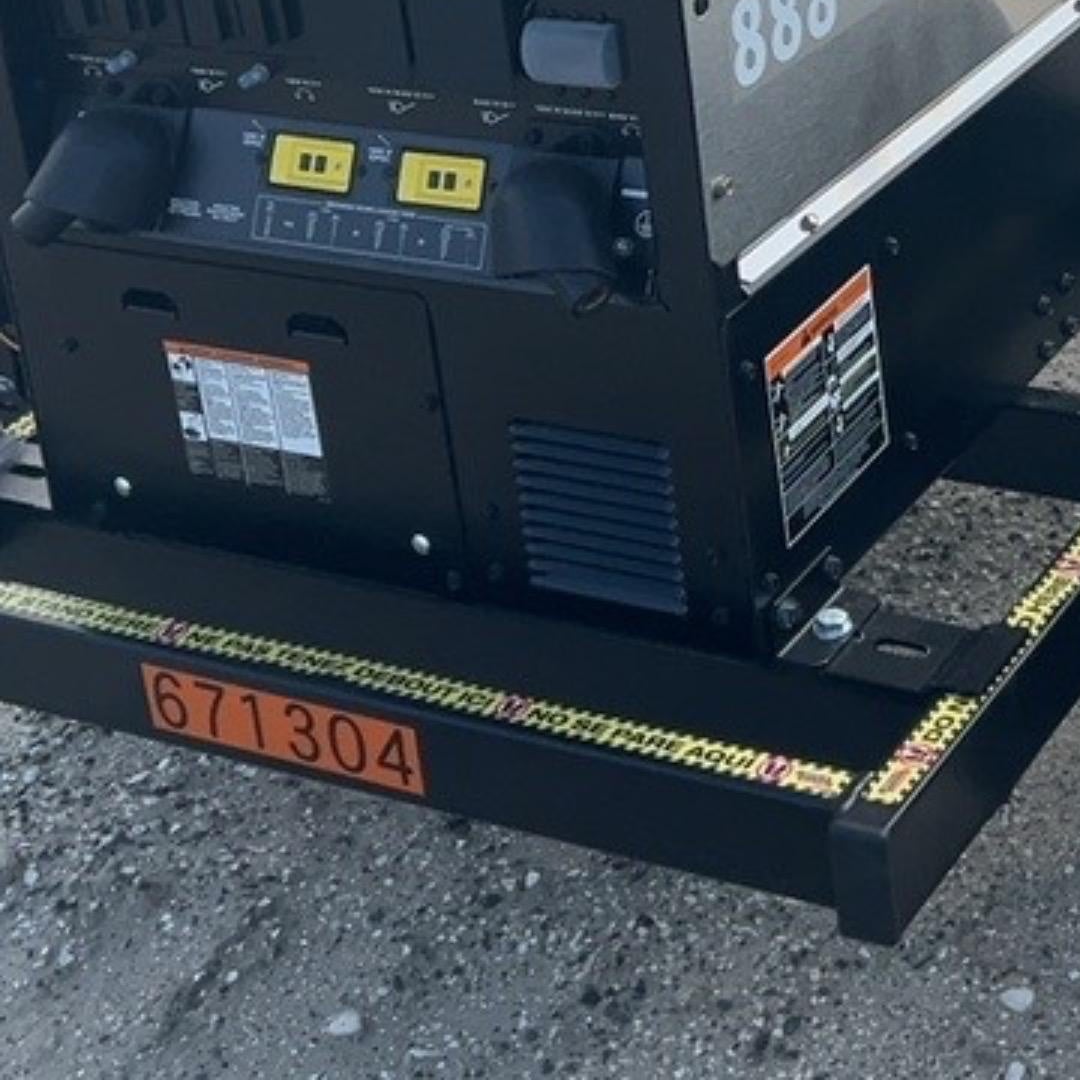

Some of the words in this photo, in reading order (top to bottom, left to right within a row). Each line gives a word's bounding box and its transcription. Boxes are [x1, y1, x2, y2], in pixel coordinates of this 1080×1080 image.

[355, 665, 453, 698] DEBOUT
[153, 671, 413, 787] 671304
[527, 706, 569, 724] NO
[571, 716, 608, 734] SE
[610, 726, 683, 753] PARE
